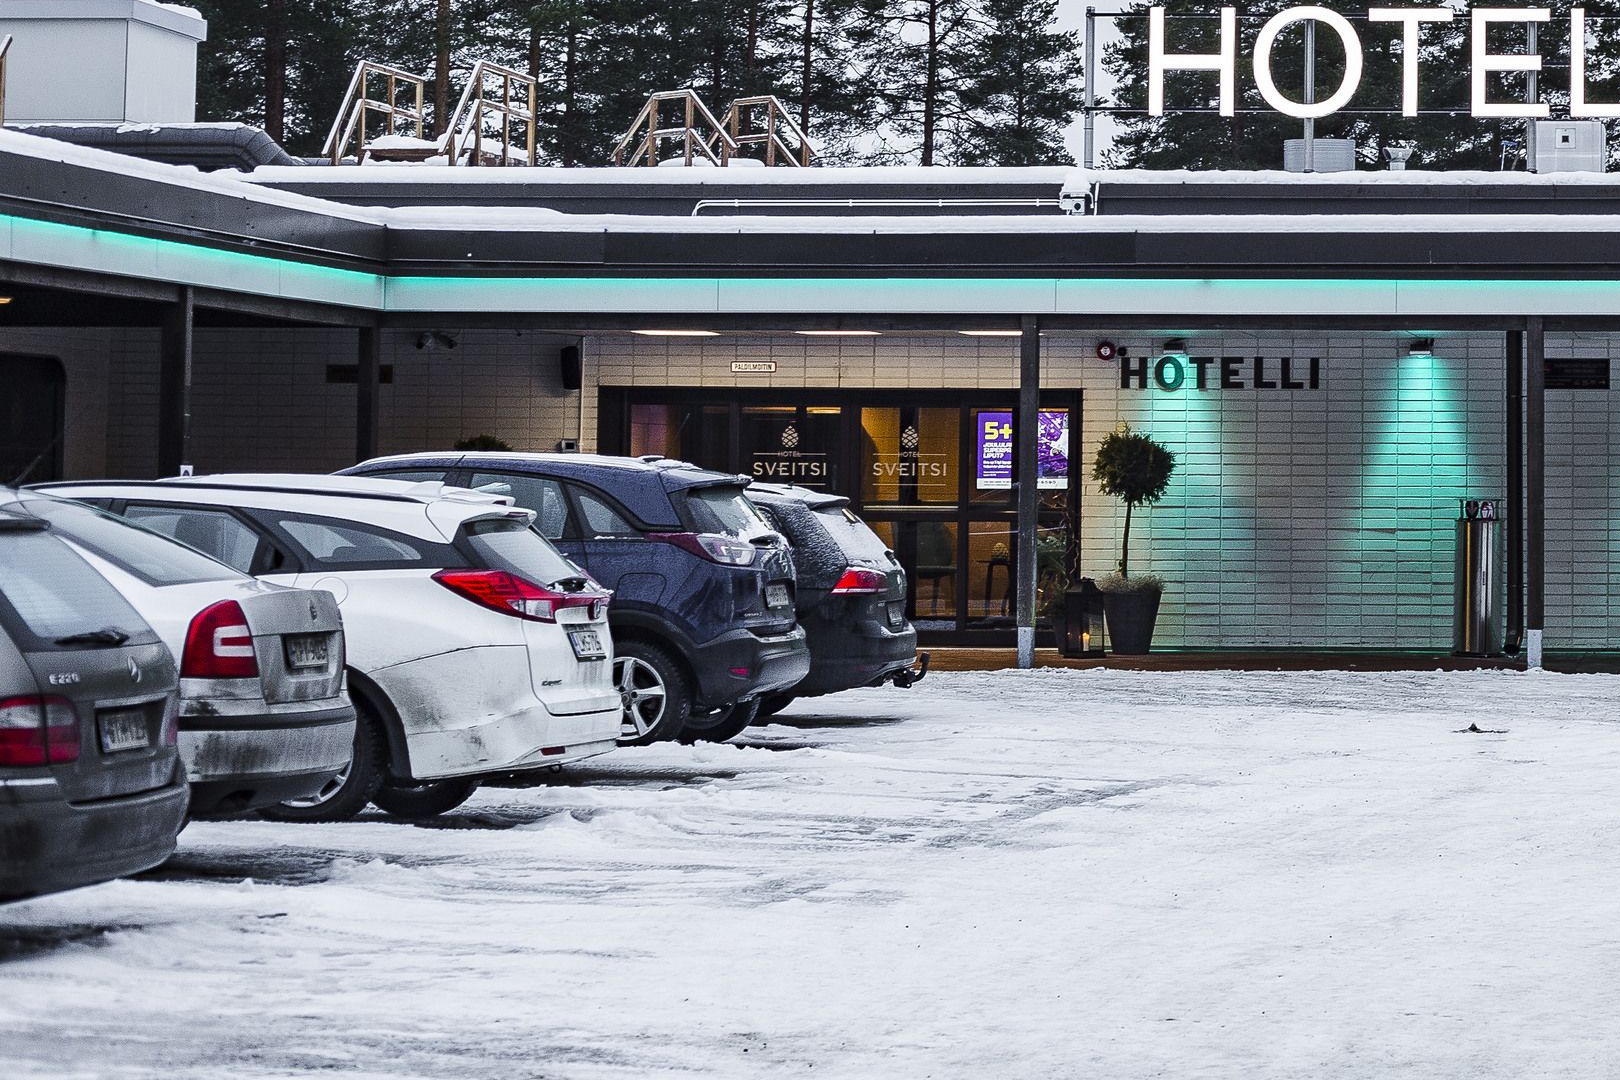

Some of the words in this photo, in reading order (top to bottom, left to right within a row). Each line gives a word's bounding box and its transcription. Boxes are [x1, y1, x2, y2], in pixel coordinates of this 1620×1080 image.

[1120, 356, 1320, 391] HOTELLI
[753, 462, 827, 476] SVEITSI
[873, 462, 947, 476] SVEITSI
